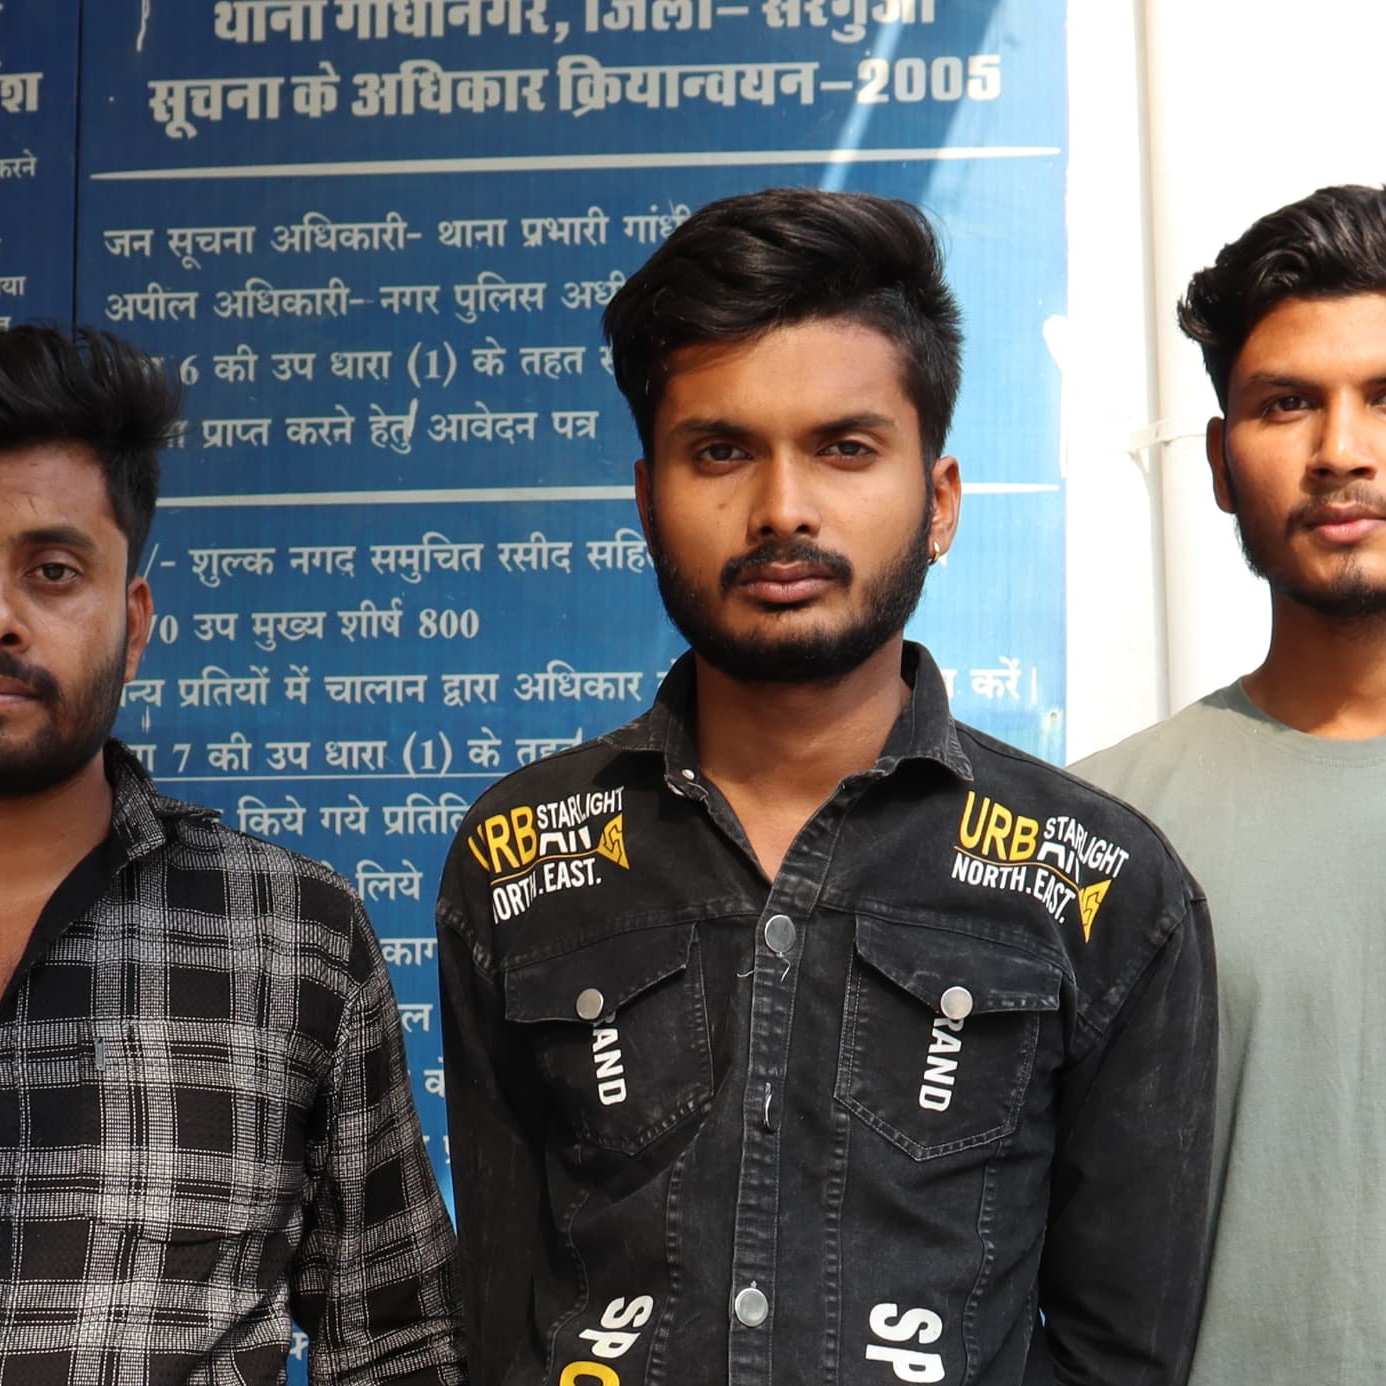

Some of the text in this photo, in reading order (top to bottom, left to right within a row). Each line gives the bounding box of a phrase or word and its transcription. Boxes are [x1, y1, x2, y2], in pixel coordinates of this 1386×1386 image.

[148, 77, 283, 139] सूचना
[292, 61, 341, 118] के
[353, 61, 549, 117] अधिकार
[104, 230, 155, 258] जन
[168, 227, 257, 270] सूचना
[439, 220, 509, 249] थाना
[522, 207, 610, 248] प्रभारी
[106, 283, 200, 322] अपील
[380, 285, 440, 316] नगर
[455, 272, 548, 324] पुलिस
[214, 345, 259, 383] की
[272, 354, 317, 381] उप
[332, 352, 393, 381] धारा
[473, 337, 507, 377] के
[520, 347, 588, 380] तहत
[429, 402, 539, 445] आवेदन
[553, 412, 601, 441] पत्र
[290, 547, 357, 578] नगद
[371, 533, 485, 584] समुचित
[499, 532, 573, 574] रसीद
[194, 614, 239, 641] उप
[420, 610, 480, 639] 800
[285, 665, 312, 705] में
[325, 676, 429, 705] चालान
[442, 675, 501, 707] द्वारा
[514, 660, 643, 702] अधिकार
[208, 733, 251, 772] की
[267, 741, 309, 771] उप
[326, 739, 387, 771] धारा
[467, 727, 502, 768] के
[238, 794, 370, 836] किये गये
[536, 786, 625, 830] STARLIGHT
[1043, 816, 1129, 878] STARLIGHT
